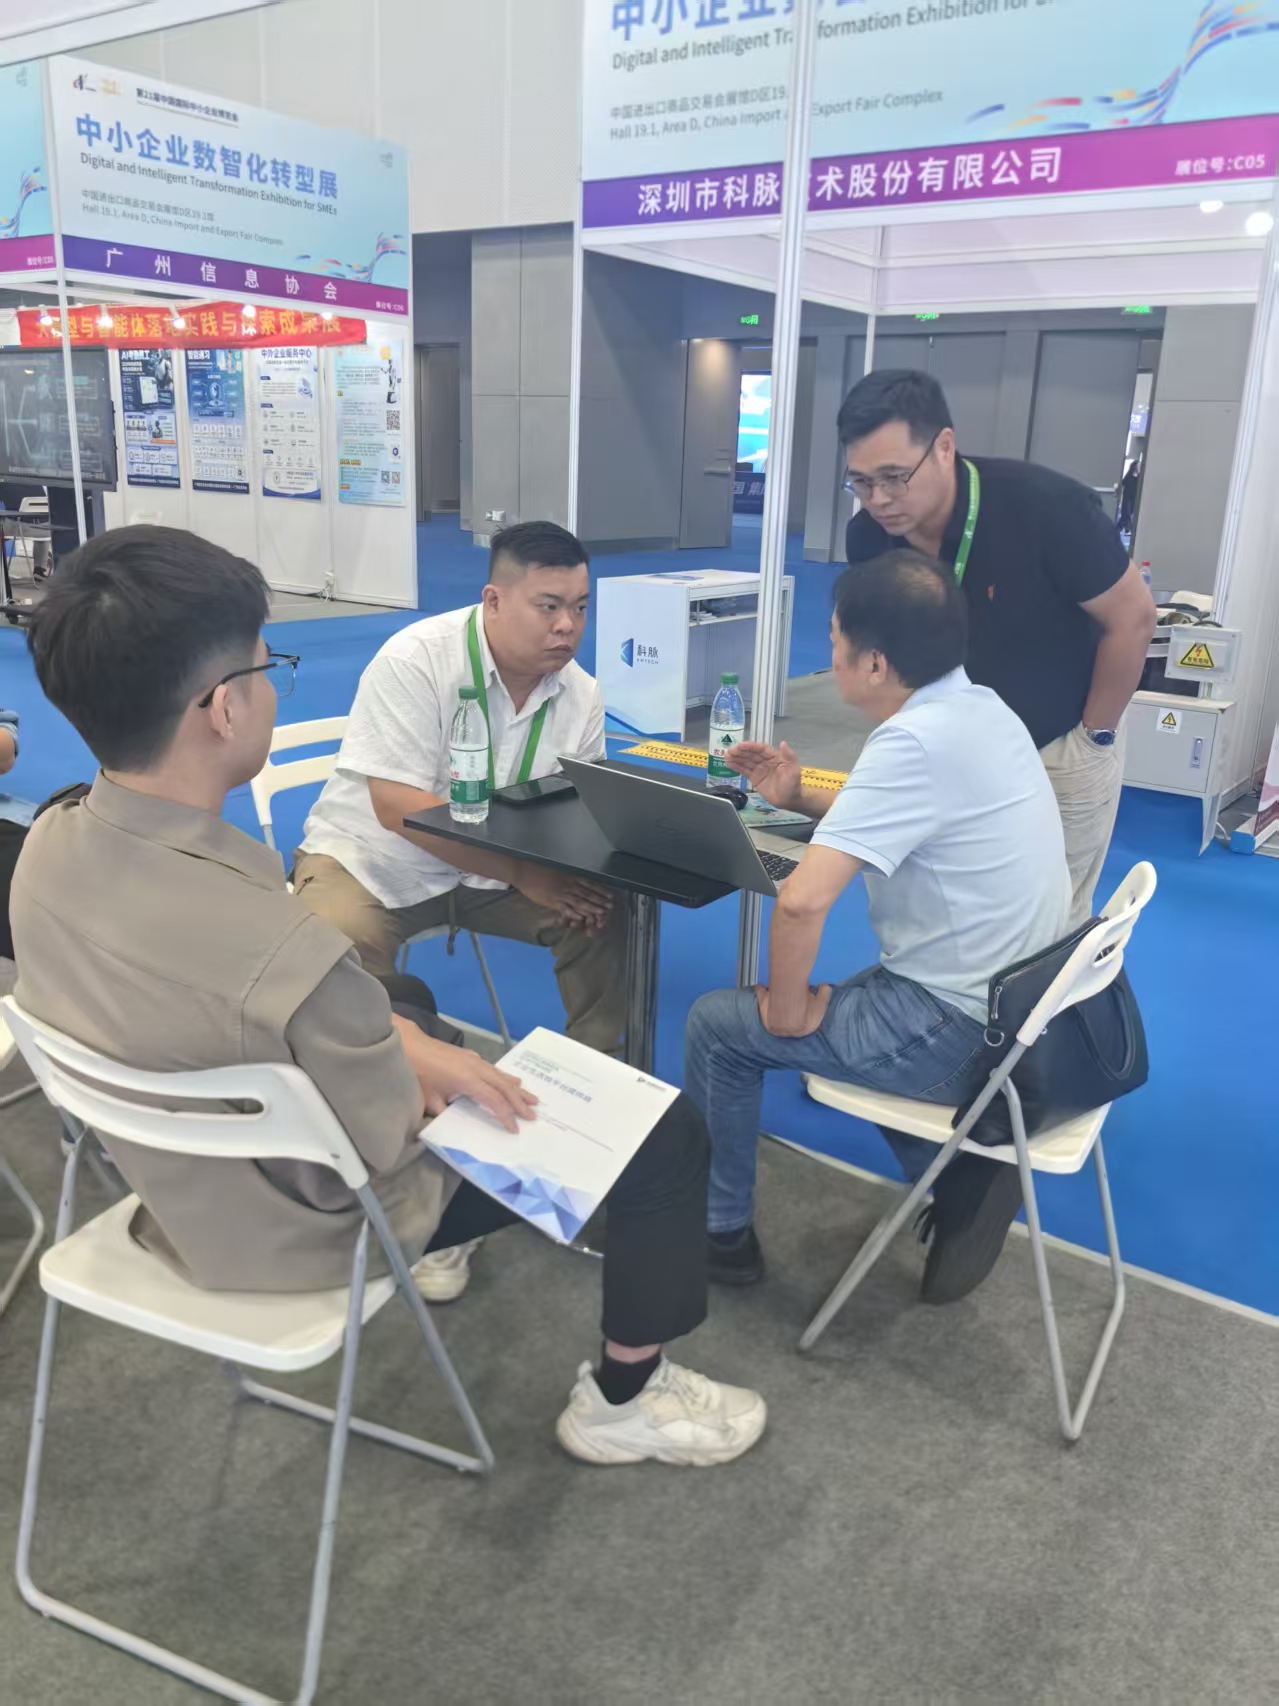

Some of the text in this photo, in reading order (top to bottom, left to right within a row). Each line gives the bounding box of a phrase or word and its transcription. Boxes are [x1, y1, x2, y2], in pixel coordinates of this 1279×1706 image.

[613, 48, 658, 72] Digital
[661, 43, 689, 63] and
[692, 32, 770, 58] Intelligent
[774, 12, 901, 45] Trformation
[906, 0, 999, 26] Exhibition
[610, 125, 632, 140] Hall
[663, 120, 687, 134] Area
[704, 114, 737, 129] China
[740, 109, 781, 126] Import
[811, 97, 851, 117] Export
[855, 93, 881, 111] Fair
[883, 89, 943, 109] Complex
[76, 113, 338, 199] 中小企业数智化转型展
[638, 147, 1062, 216] 深圳市科脉术股份有限公司
[80, 152, 337, 215] Digital and Intelligent Transformation Exhibition for SMEs
[82, 202, 99, 214] Hall
[121, 209, 139, 221] Area
[151, 214, 173, 227] China
[174, 218, 199, 231] Import
[106, 248, 338, 301] 广州信息协会
[637, 644, 659, 658] 科脉
